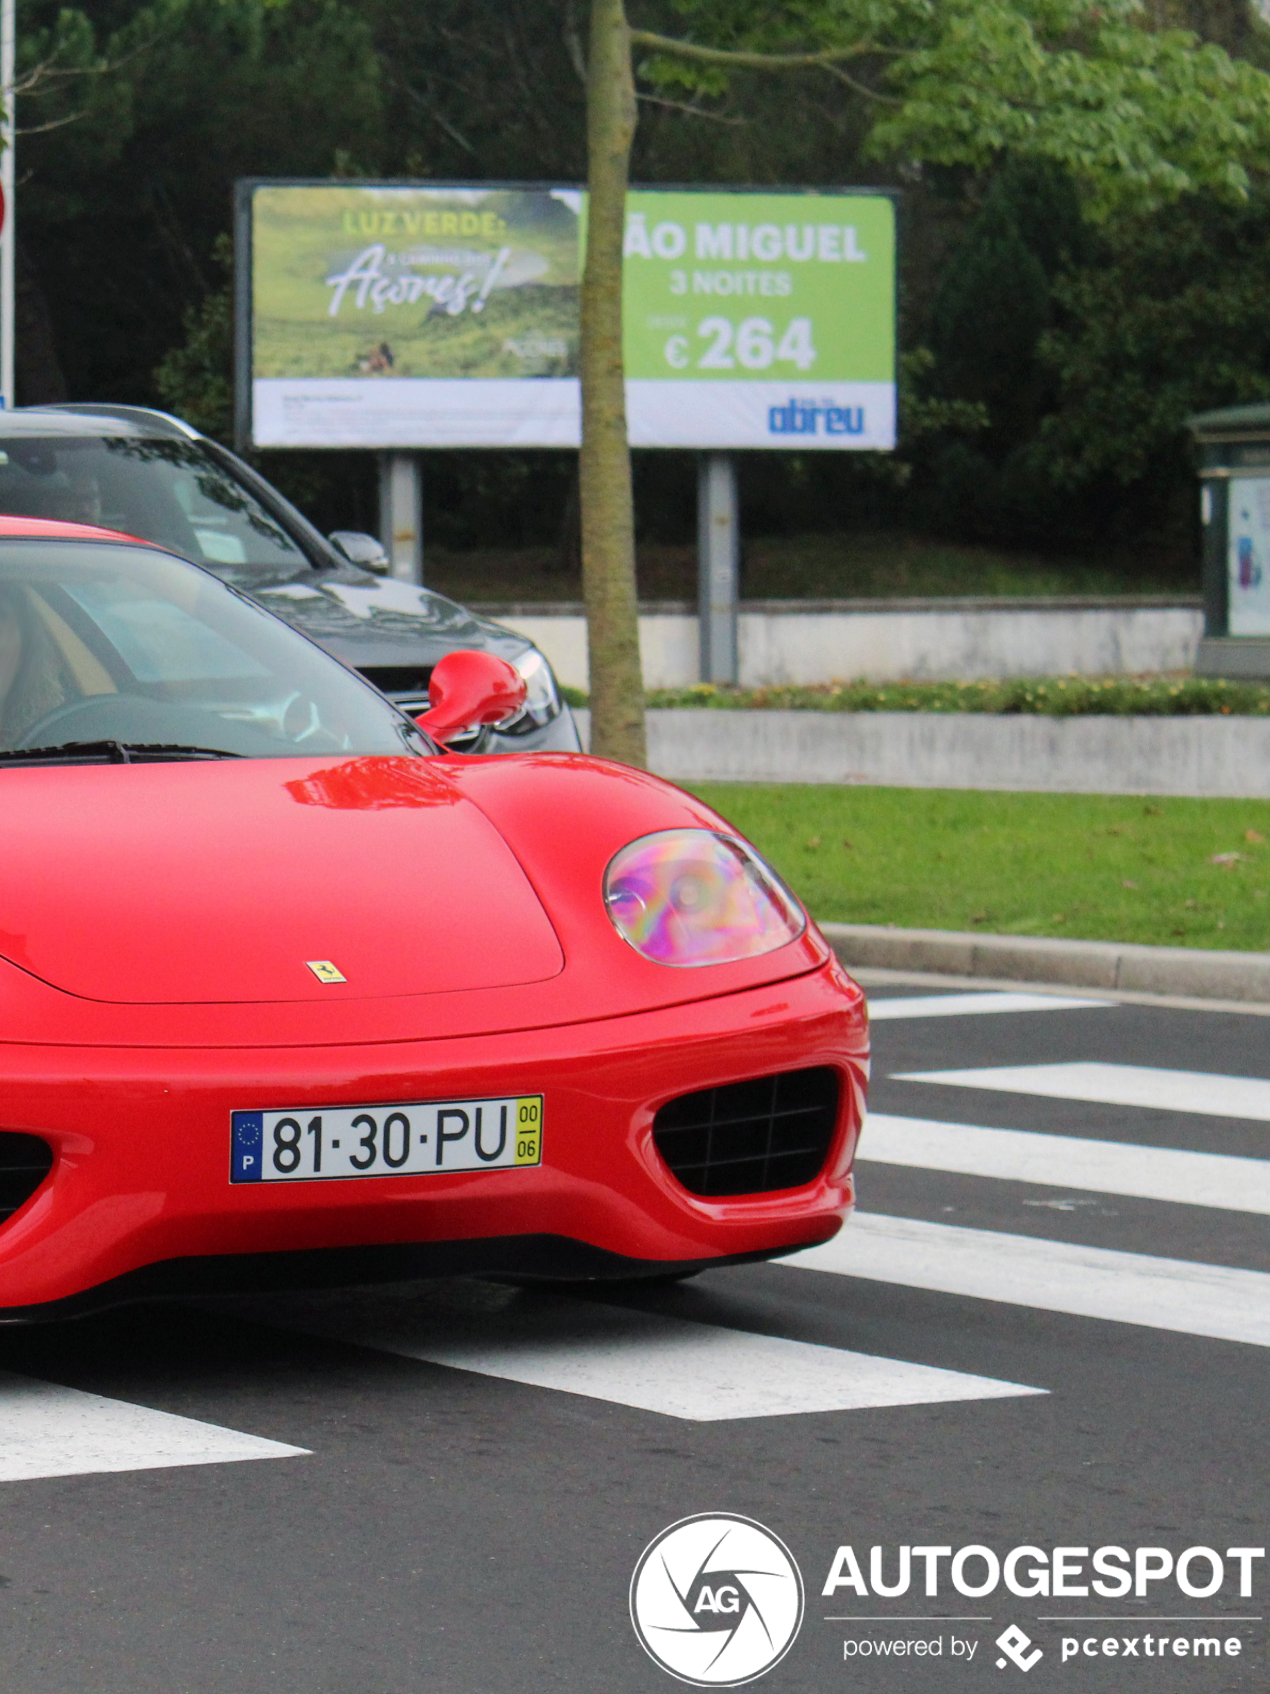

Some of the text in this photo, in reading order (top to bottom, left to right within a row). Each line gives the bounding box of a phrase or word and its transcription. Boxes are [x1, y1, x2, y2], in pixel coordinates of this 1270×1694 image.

[343, 211, 506, 236] LUZ VERDE:
[623, 211, 867, 262] ÃO MIGUEL
[326, 243, 511, 316] Açores!
[669, 269, 792, 296] 3 NOITES
[768, 397, 864, 435] abreu
[519, 1105, 538, 1123] 00
[517, 1140, 536, 1158] 06
[242, 1155, 255, 1171] P
